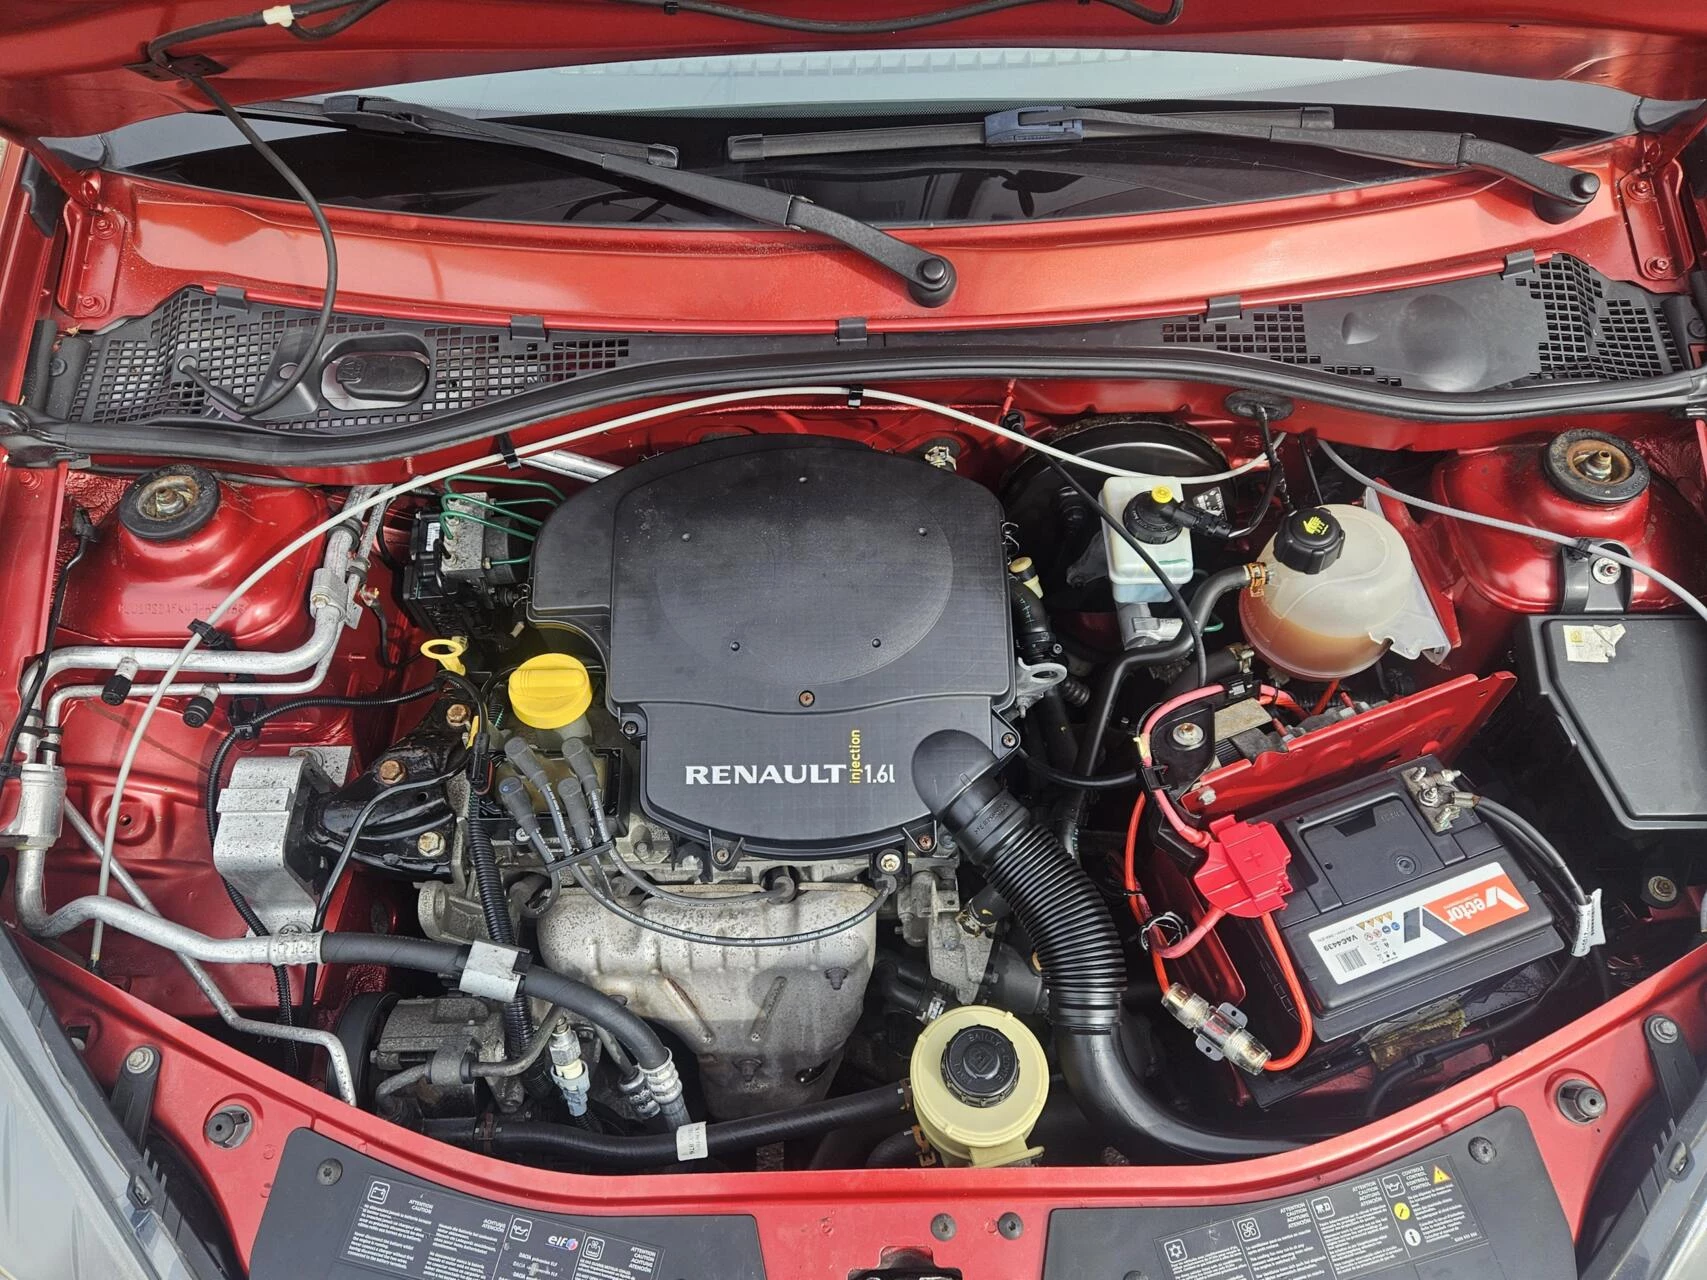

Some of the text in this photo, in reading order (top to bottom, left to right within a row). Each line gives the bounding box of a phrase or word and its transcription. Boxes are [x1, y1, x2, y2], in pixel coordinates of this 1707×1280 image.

[685, 764, 847, 785] RENAULT
[849, 729, 864, 785] injection
[548, 1235, 568, 1247] elf
